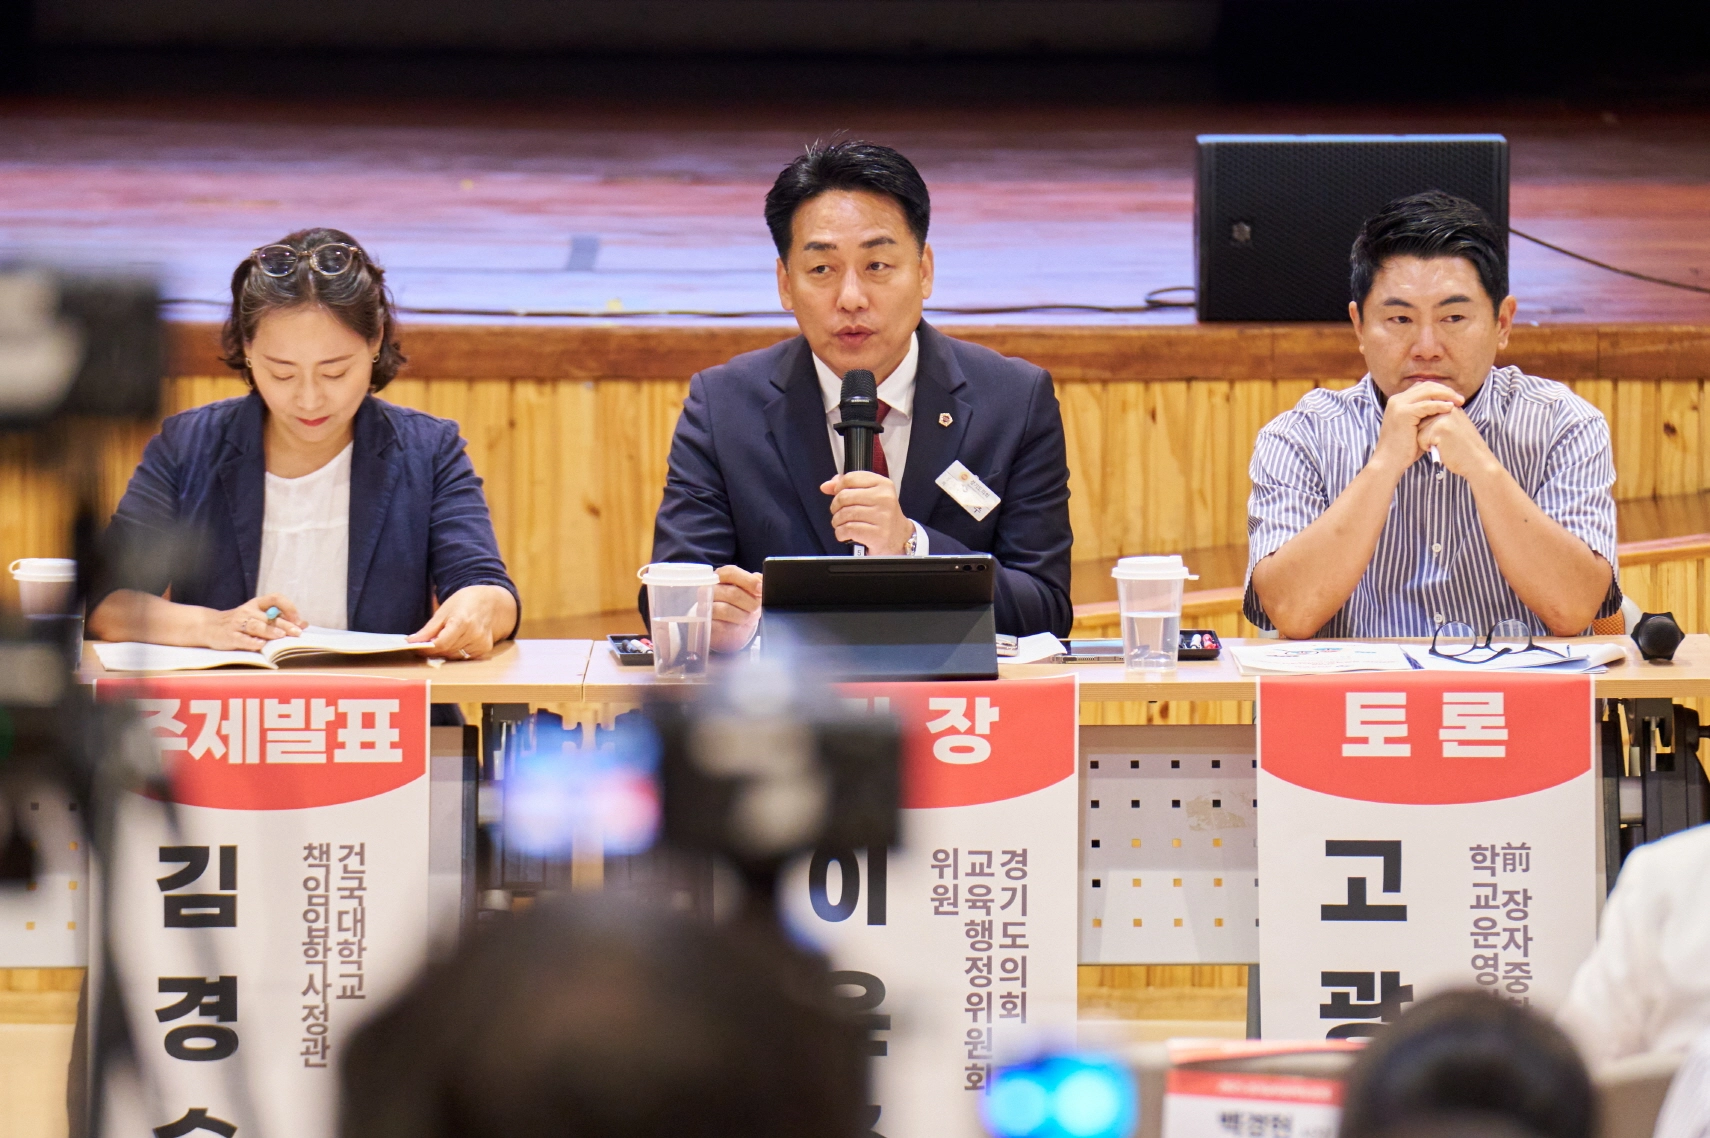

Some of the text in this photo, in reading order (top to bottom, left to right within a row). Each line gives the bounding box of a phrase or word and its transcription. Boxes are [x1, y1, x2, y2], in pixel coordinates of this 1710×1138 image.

[300, 842, 332, 1068] 책임입학사정관
[336, 842, 367, 1000] 건국대학교
[930, 847, 960, 916] 위원
[998, 848, 1030, 1024] 경기도의회
[1469, 844, 1500, 999] 학교운영
[1501, 888, 1534, 1008] 장자중
[964, 849, 996, 1096] 교육행정위원회
